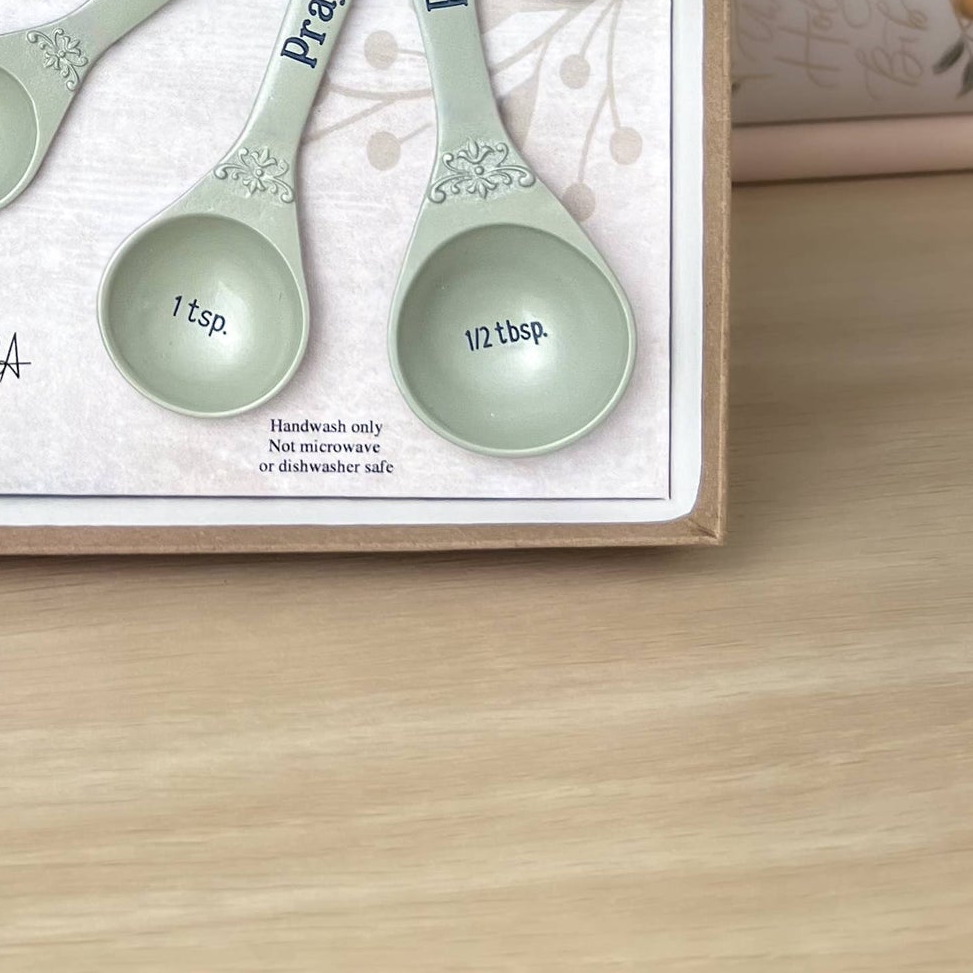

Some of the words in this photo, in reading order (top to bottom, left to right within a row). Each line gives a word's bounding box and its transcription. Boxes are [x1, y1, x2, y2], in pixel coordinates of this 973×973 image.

[173, 295, 182, 316] 1
[188, 299, 227, 337] tsp.
[465, 326, 493, 351] 1/2
[495, 319, 548, 345] tbsp.
[270, 418, 347, 433] Handwash
[351, 420, 383, 437] only
[269, 439, 295, 453] Not
[300, 439, 381, 453] microwave
[259, 462, 274, 472] or
[278, 459, 360, 473] dishwasher
[365, 460, 394, 473] safe
